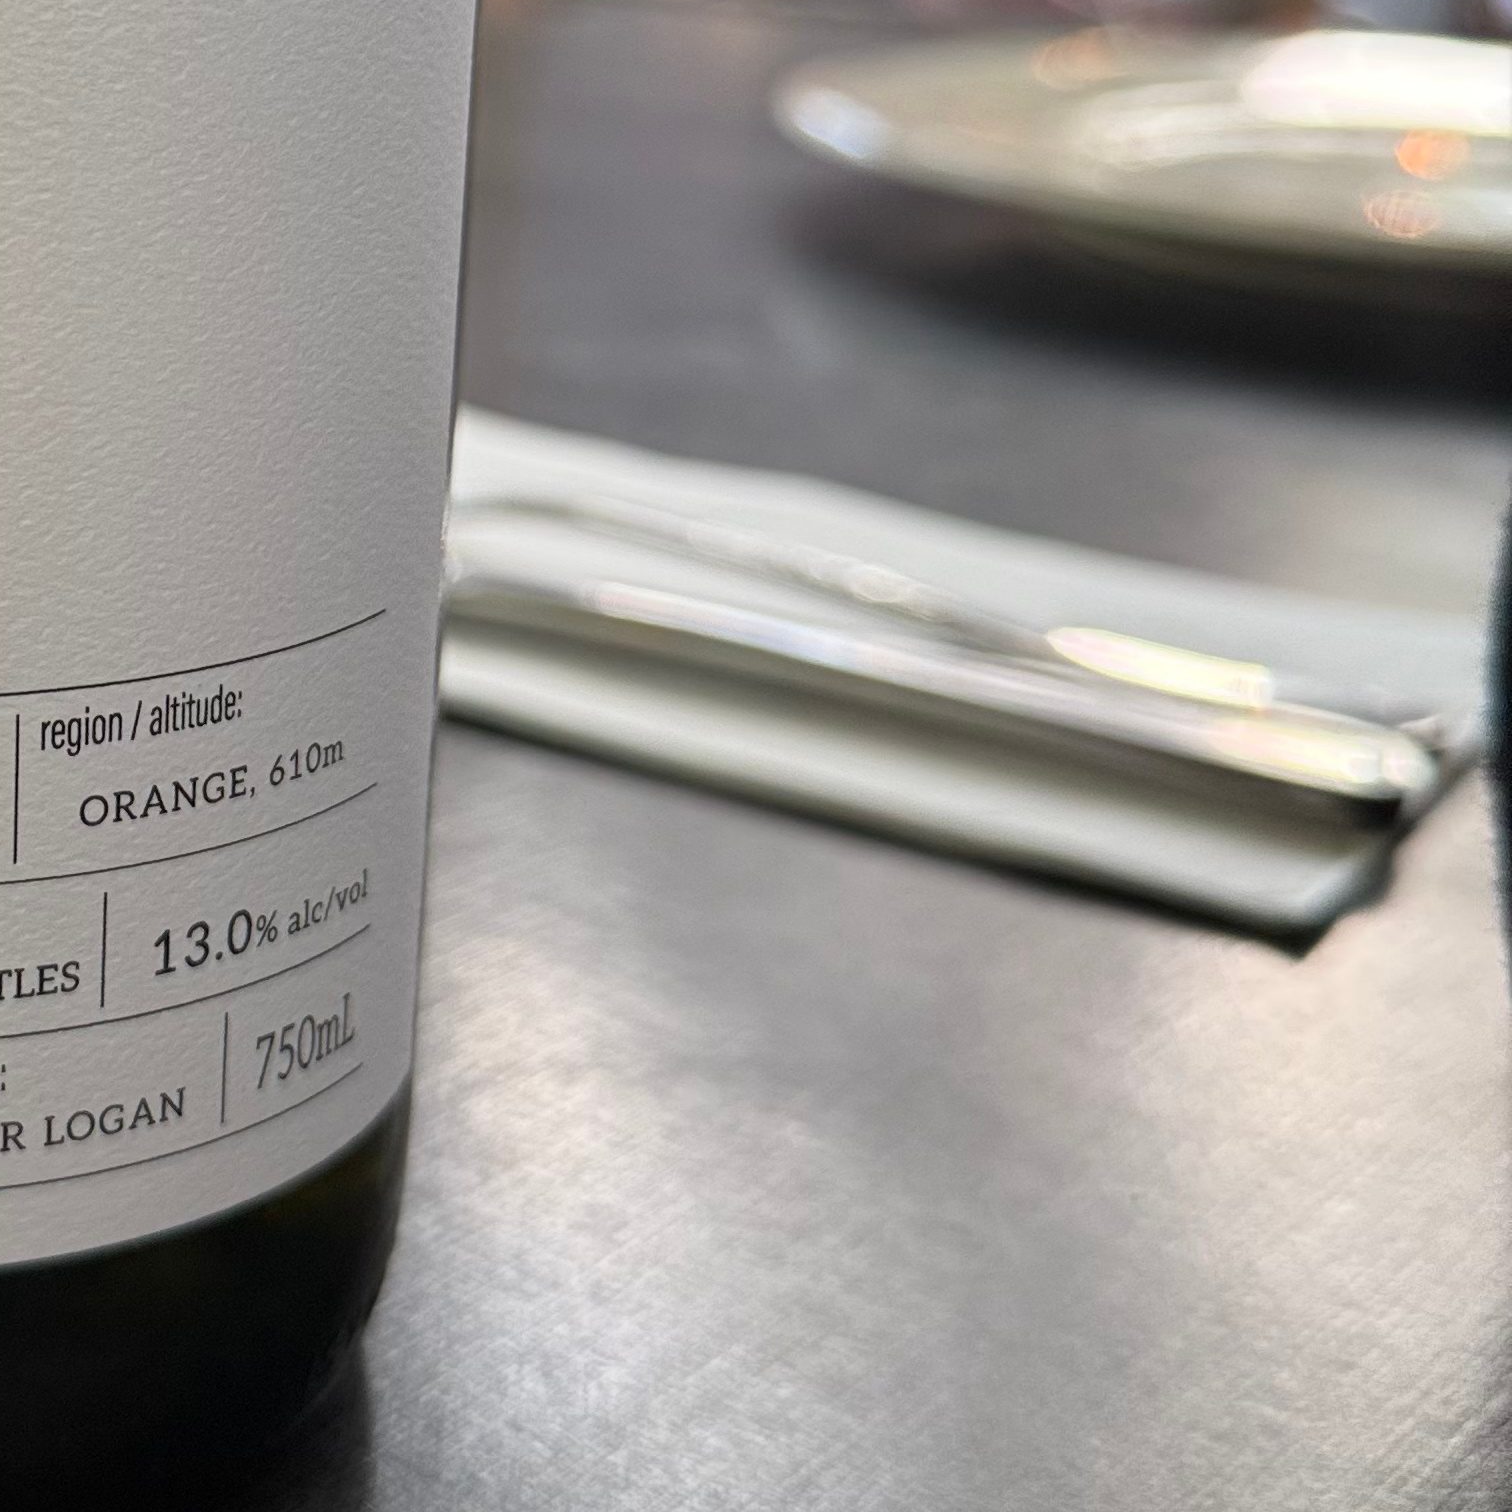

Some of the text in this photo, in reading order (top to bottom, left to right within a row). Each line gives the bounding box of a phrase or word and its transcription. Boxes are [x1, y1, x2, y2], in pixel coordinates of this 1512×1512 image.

[40, 708, 123, 757] region
[149, 684, 243, 736] altitude:
[79, 738, 344, 827] ORANGE, 610m
[154, 868, 369, 976] 13.0% alc/vol
[254, 992, 356, 1089] 750mL
[43, 1086, 187, 1146] LOGAN
